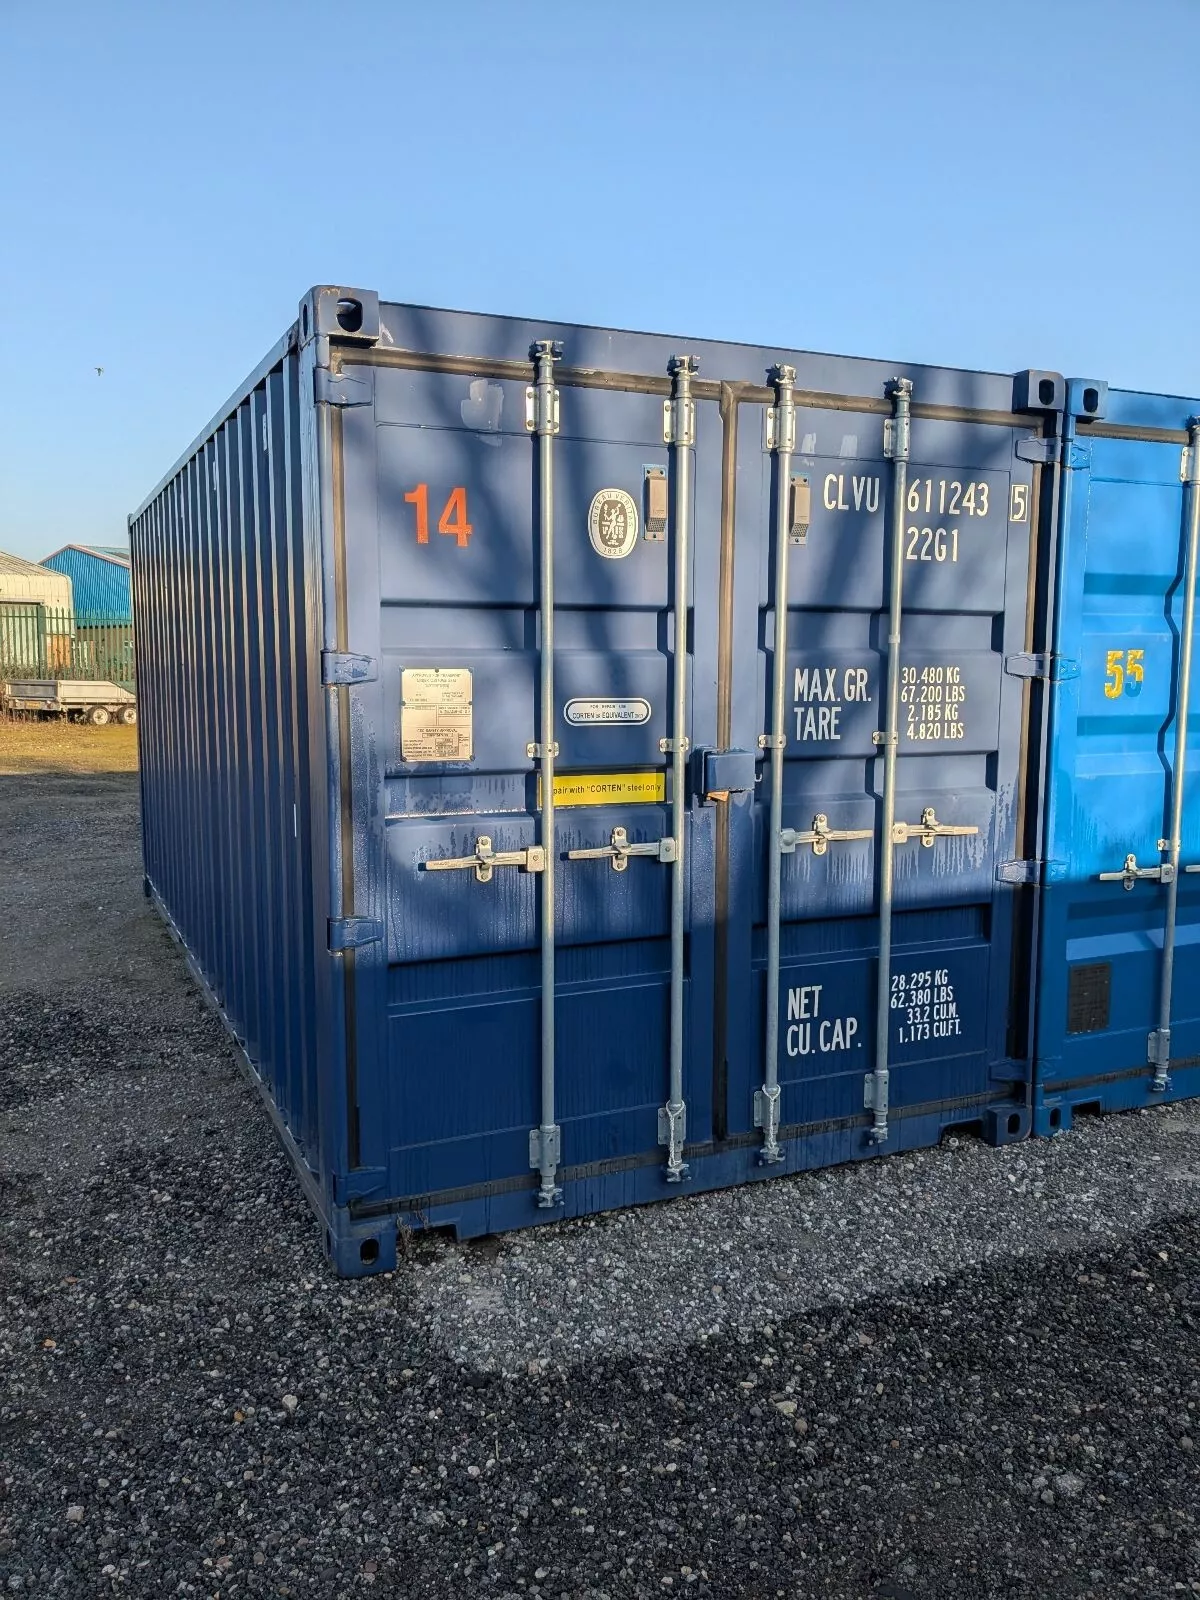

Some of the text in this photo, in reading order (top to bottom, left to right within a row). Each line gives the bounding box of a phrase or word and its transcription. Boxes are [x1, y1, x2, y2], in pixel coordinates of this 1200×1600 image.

[823, 473, 1025, 520] CLVU 611243 5
[404, 483, 473, 547] 14
[906, 526, 959, 562] 22G1
[901, 666, 960, 684] 30,480 KG
[1104, 649, 1144, 698] 55
[900, 685, 966, 703] 67,200 LBS
[602, 711, 635, 719] EQUIVALENT
[793, 706, 842, 741] TARE
[907, 703, 959, 722] 2,185 KG
[906, 722, 965, 740] 4,820 LBS
[553, 786, 568, 796] pair
[569, 786, 585, 794] with
[586, 783, 626, 793] "CORTEN"
[627, 783, 645, 792] steel
[891, 969, 949, 992] 28,295 KG
[787, 984, 823, 1021] NET
[890, 985, 954, 1009] 62,380 LBS
[906, 1002, 959, 1025] 33.2 CU.M.
[786, 1017, 862, 1057] CU. CAP.
[898, 1019, 962, 1044] 1,173 CU.FT.
